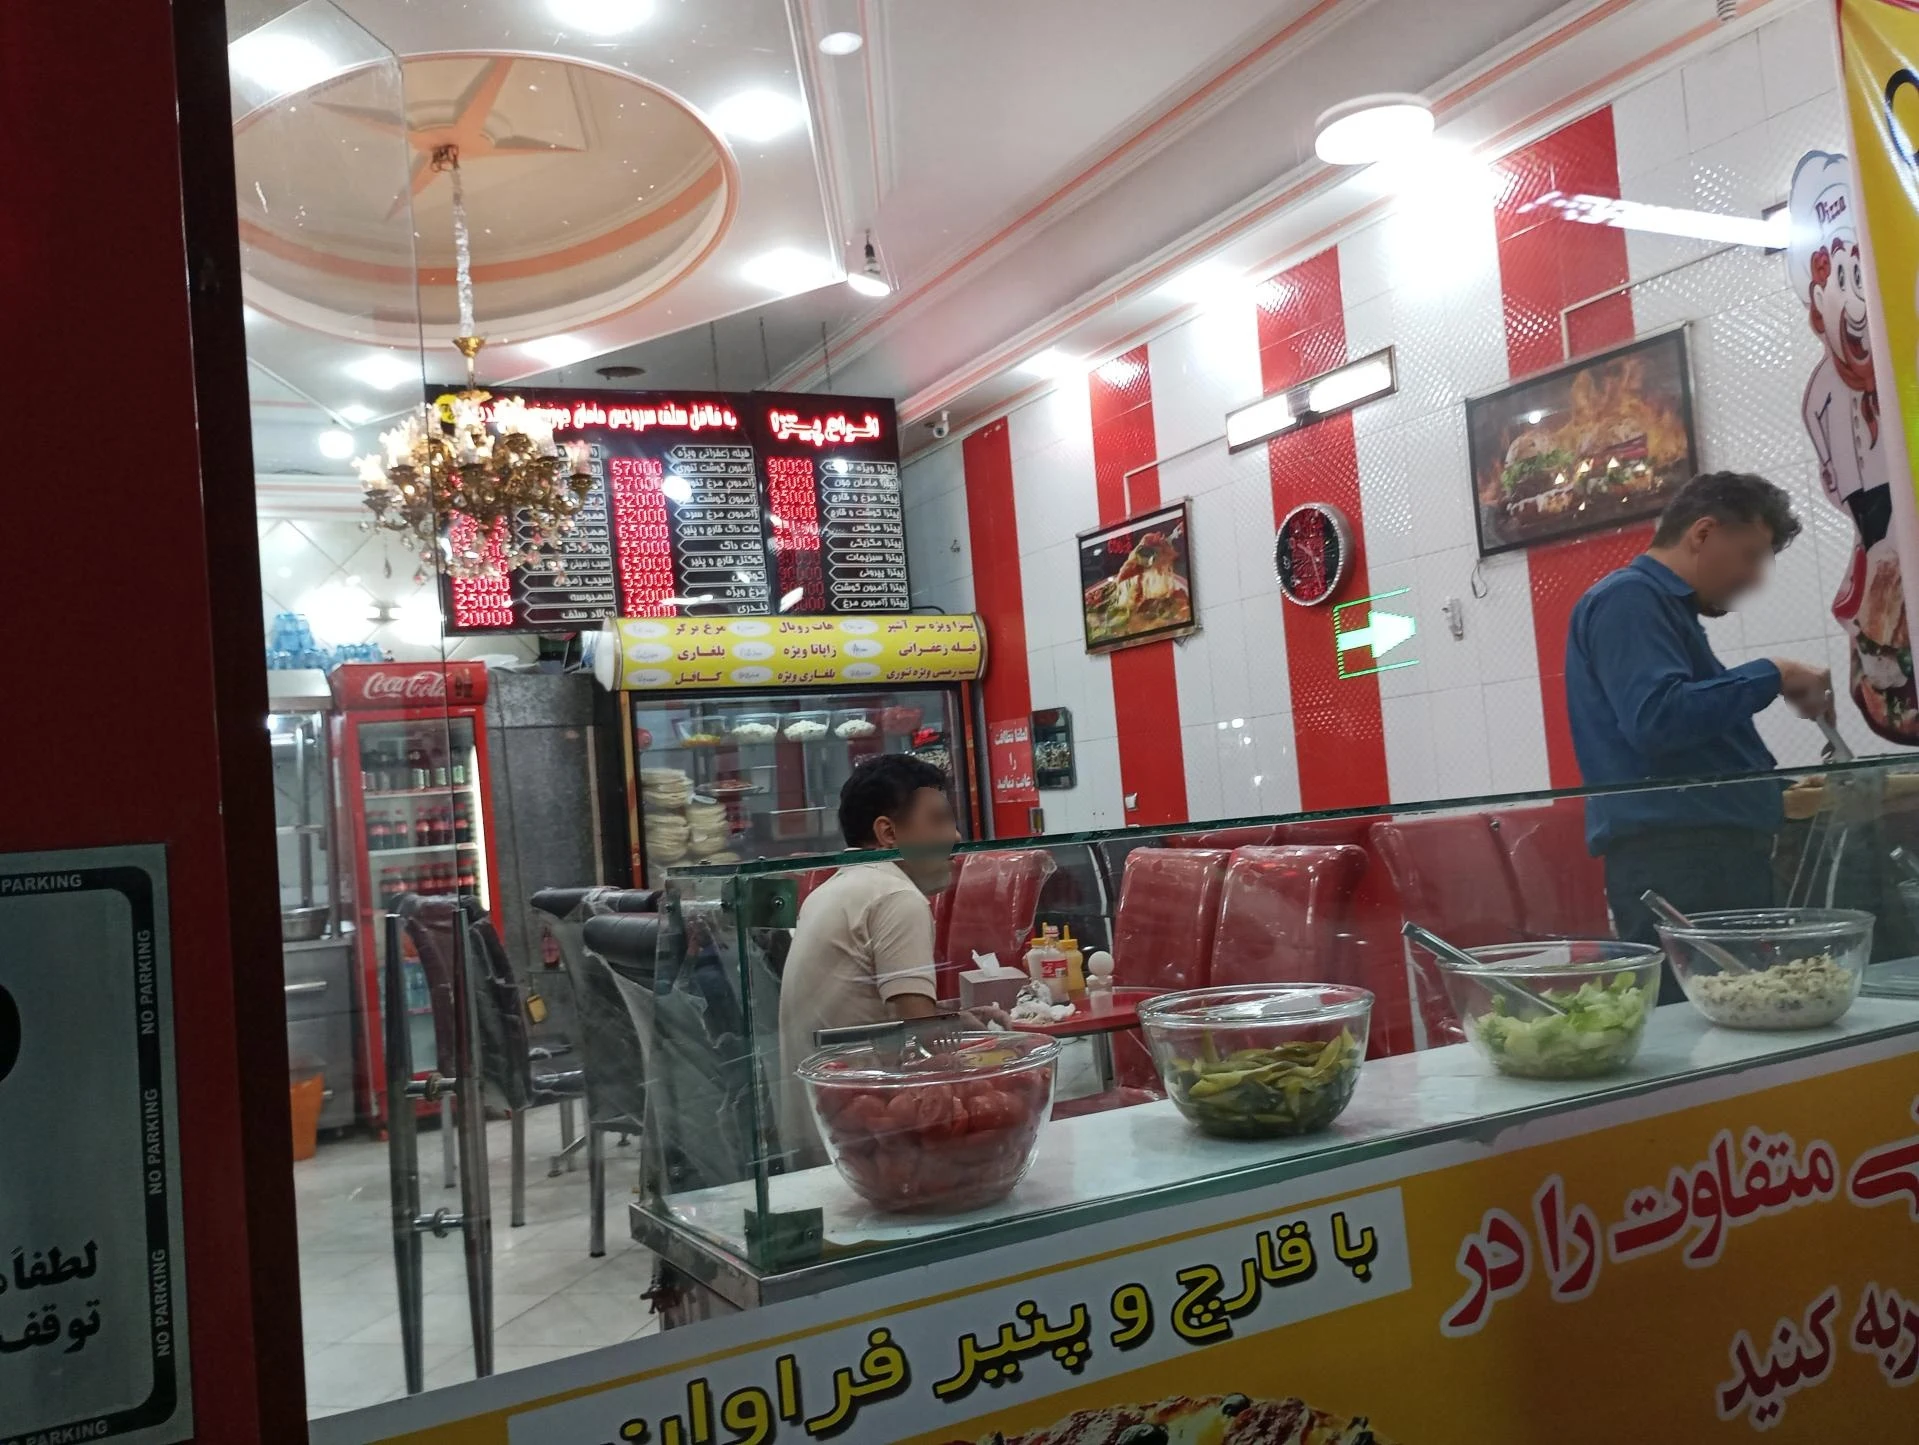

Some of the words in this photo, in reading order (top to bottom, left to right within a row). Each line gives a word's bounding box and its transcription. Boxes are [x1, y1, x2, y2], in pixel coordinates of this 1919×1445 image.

[1815, 195, 1846, 224] Pizza
[608, 407, 657, 432] سرویس
[657, 402, 688, 426] سلف
[690, 404, 722, 430] فلافل
[770, 410, 824, 447] پیتزا
[825, 415, 880, 442] انواع
[877, 464, 897, 474] پیتزا
[706, 479, 724, 490] مرغ
[834, 478, 851, 488] جون
[853, 479, 878, 488] مامان
[830, 493, 850, 503] قارچ
[860, 494, 877, 504] مرغ
[880, 493, 898, 503] پیتزا
[685, 511, 703, 520] سرد
[706, 510, 724, 521] مرغ
[830, 509, 848, 518] قارچ
[883, 509, 900, 519] پیتزا
[725, 525, 741, 533] داک
[742, 525, 760, 533] هات
[883, 523, 902, 533] پیتزا
[720, 541, 739, 550] داک
[741, 541, 761, 550] هات
[885, 538, 903, 548] پیتزا
[846, 553, 883, 562] سبزیجات
[886, 553, 903, 562] پیتزا
[887, 568, 905, 578] پیتزا
[586, 575, 612, 586] سیب
[749, 588, 767, 598] مرغ
[890, 583, 907, 594] پیتزا
[455, 593, 512, 609] 25000
[842, 598, 859, 609] مرغ
[890, 597, 908, 608] پیتزا
[561, 608, 588, 619] سلف
[737, 603, 769, 615] بندری
[457, 609, 513, 626] 20000
[811, 621, 834, 631] هات
[677, 645, 725, 661] بلغاری
[783, 644, 808, 659] ویژه
[898, 642, 949, 656] زعفرانی
[951, 641, 977, 655] فیله
[1008, 751, 1017, 771] را
[1, 873, 82, 893] PARKING
[137, 929, 154, 1005] PARKING
[141, 1010, 156, 1036] NO
[144, 1087, 161, 1166] PARKING
[149, 1169, 163, 1196] NO
[1613, 1133, 1835, 1260] متفاوت
[1536, 1181, 1596, 1295] را
[1330, 1211, 1378, 1283] با
[1445, 1214, 1527, 1330] در
[151, 1248, 168, 1326] PARKING
[1171, 1220, 1318, 1346] قارچ
[1110, 1282, 1155, 1352] و
[156, 1331, 171, 1358] NO
[932, 1298, 1094, 1399] پنیر
[1721, 1292, 1836, 1423] کنید
